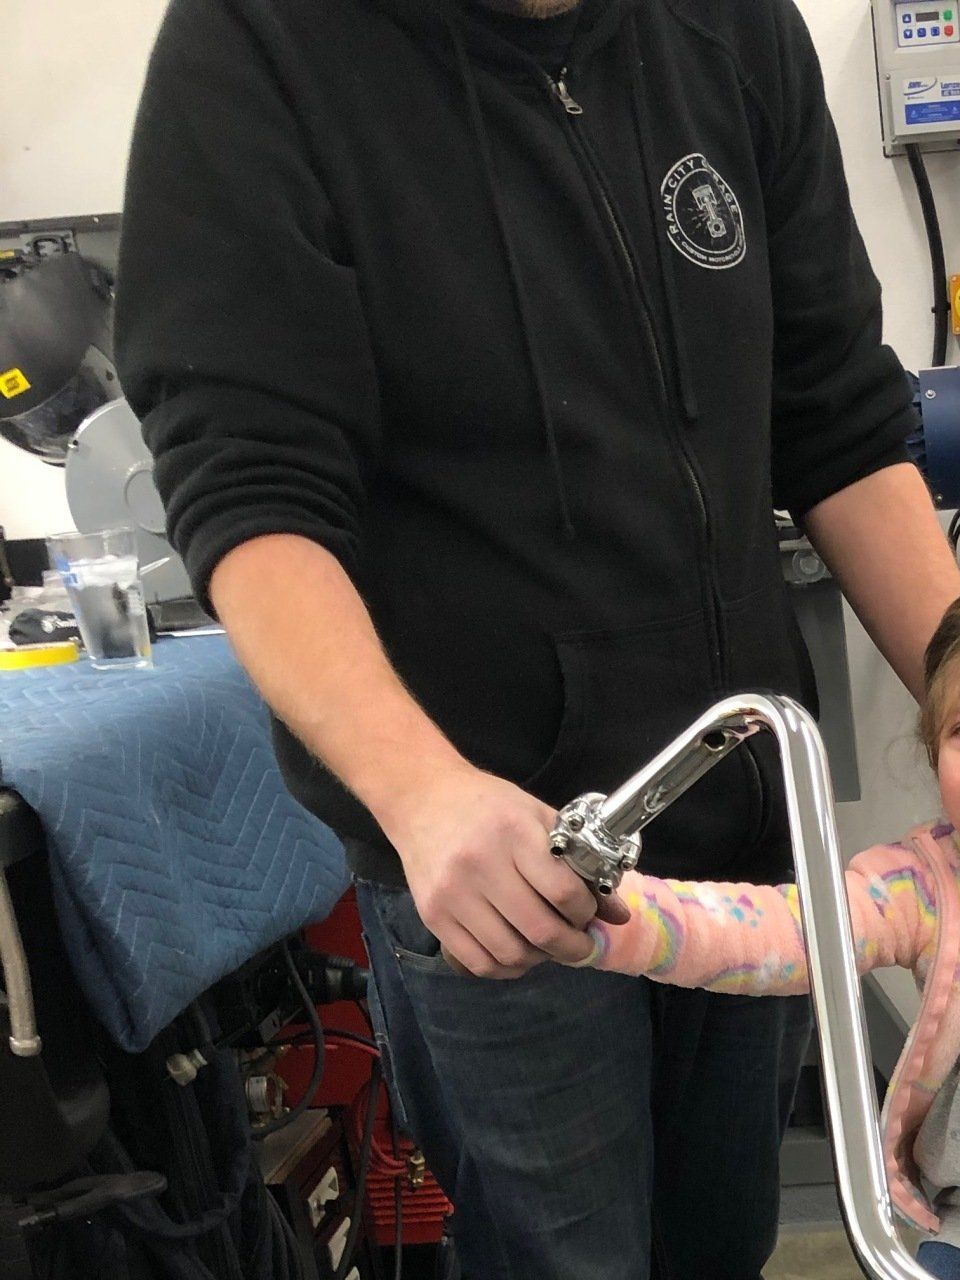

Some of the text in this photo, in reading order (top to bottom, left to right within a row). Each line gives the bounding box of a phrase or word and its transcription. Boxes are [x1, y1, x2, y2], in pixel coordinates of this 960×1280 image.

[663, 159, 738, 235] RAIN CITY GRAGE
